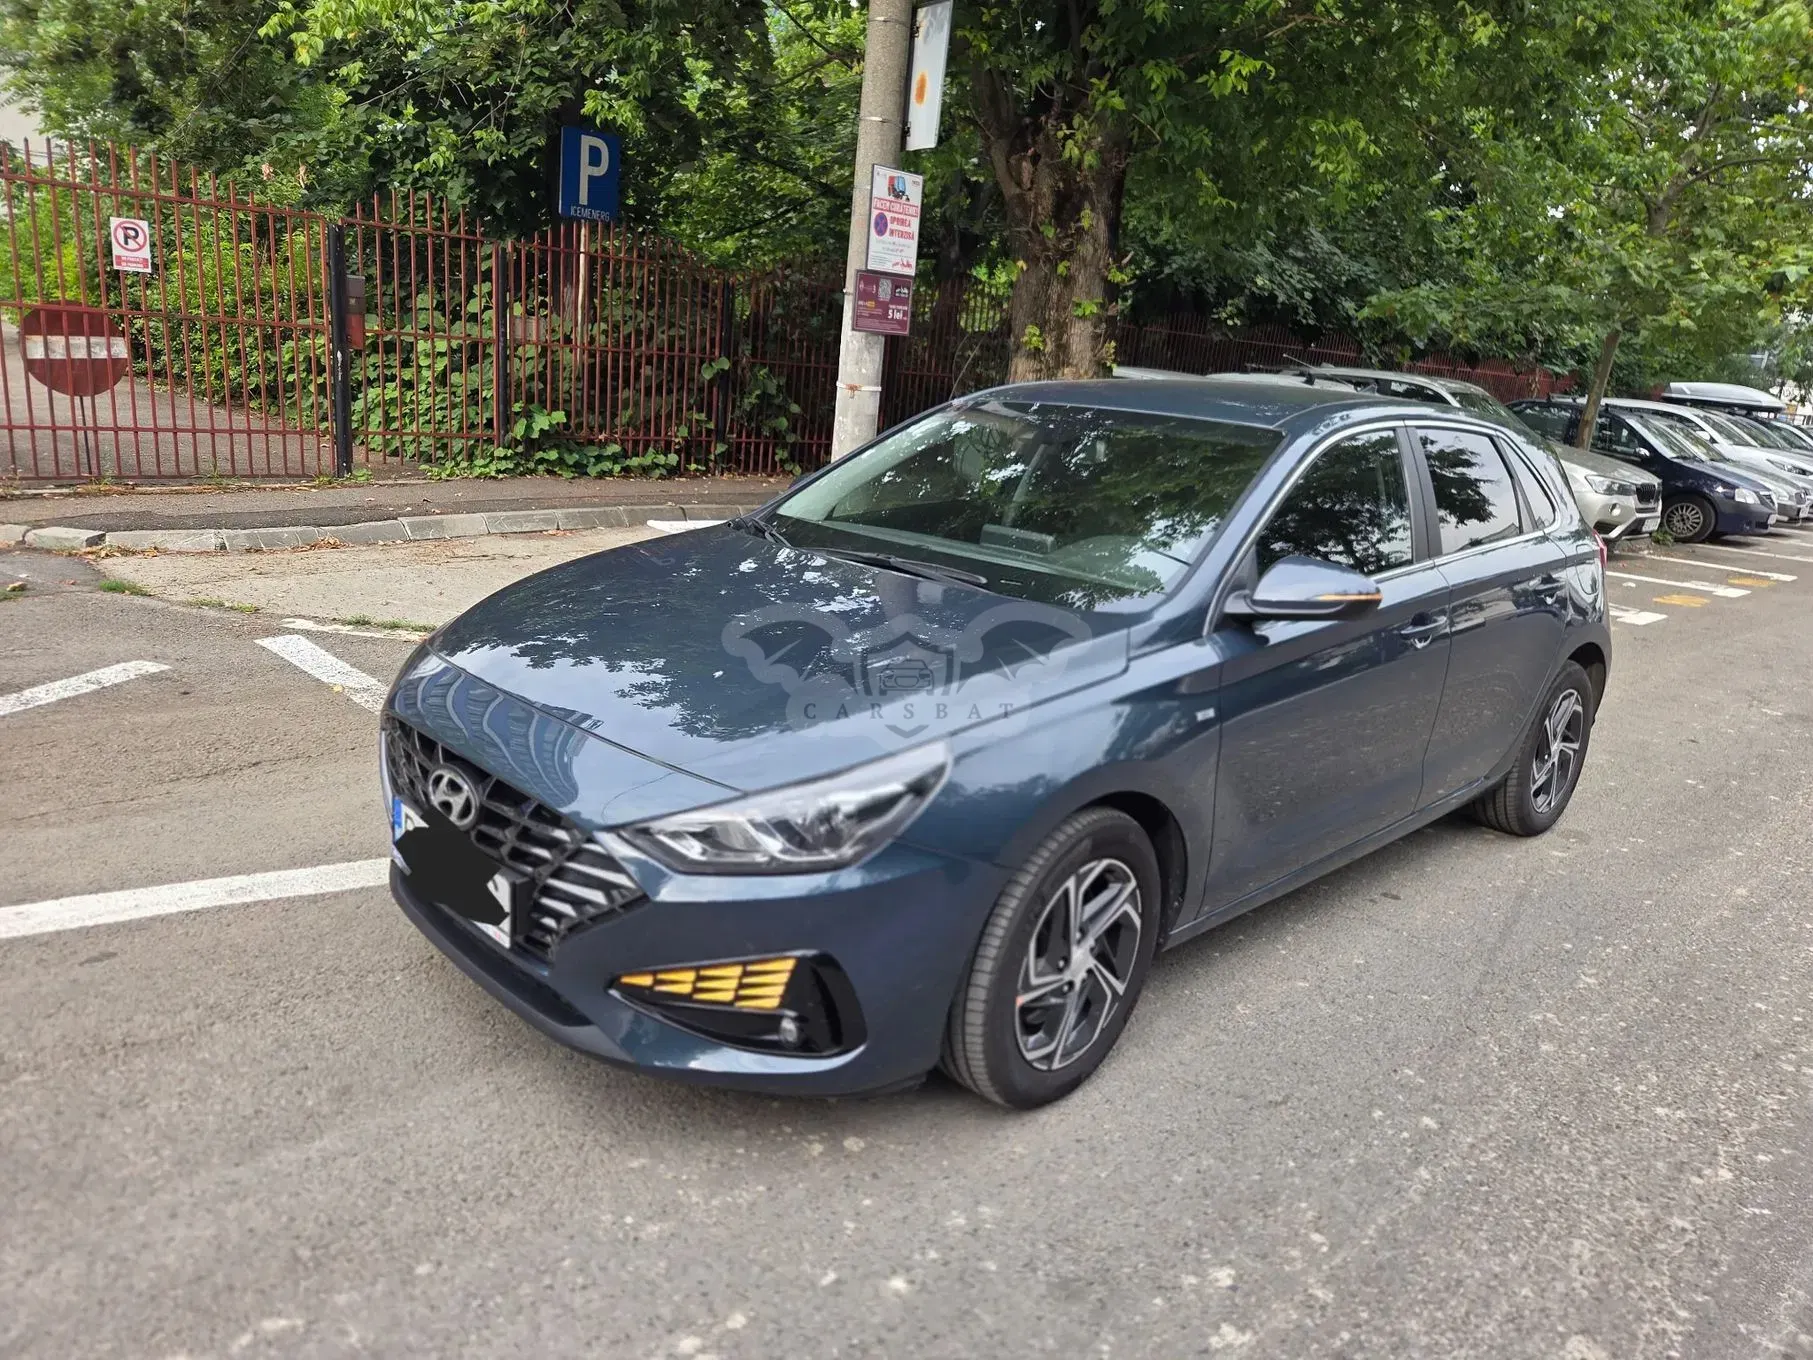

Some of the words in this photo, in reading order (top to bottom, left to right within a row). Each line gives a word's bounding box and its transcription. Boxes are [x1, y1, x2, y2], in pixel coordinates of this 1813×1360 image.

[579, 134, 609, 206] P
[570, 205, 610, 222] ICEMENERG
[123, 226, 140, 246] P
[887, 309, 893, 319] 5
